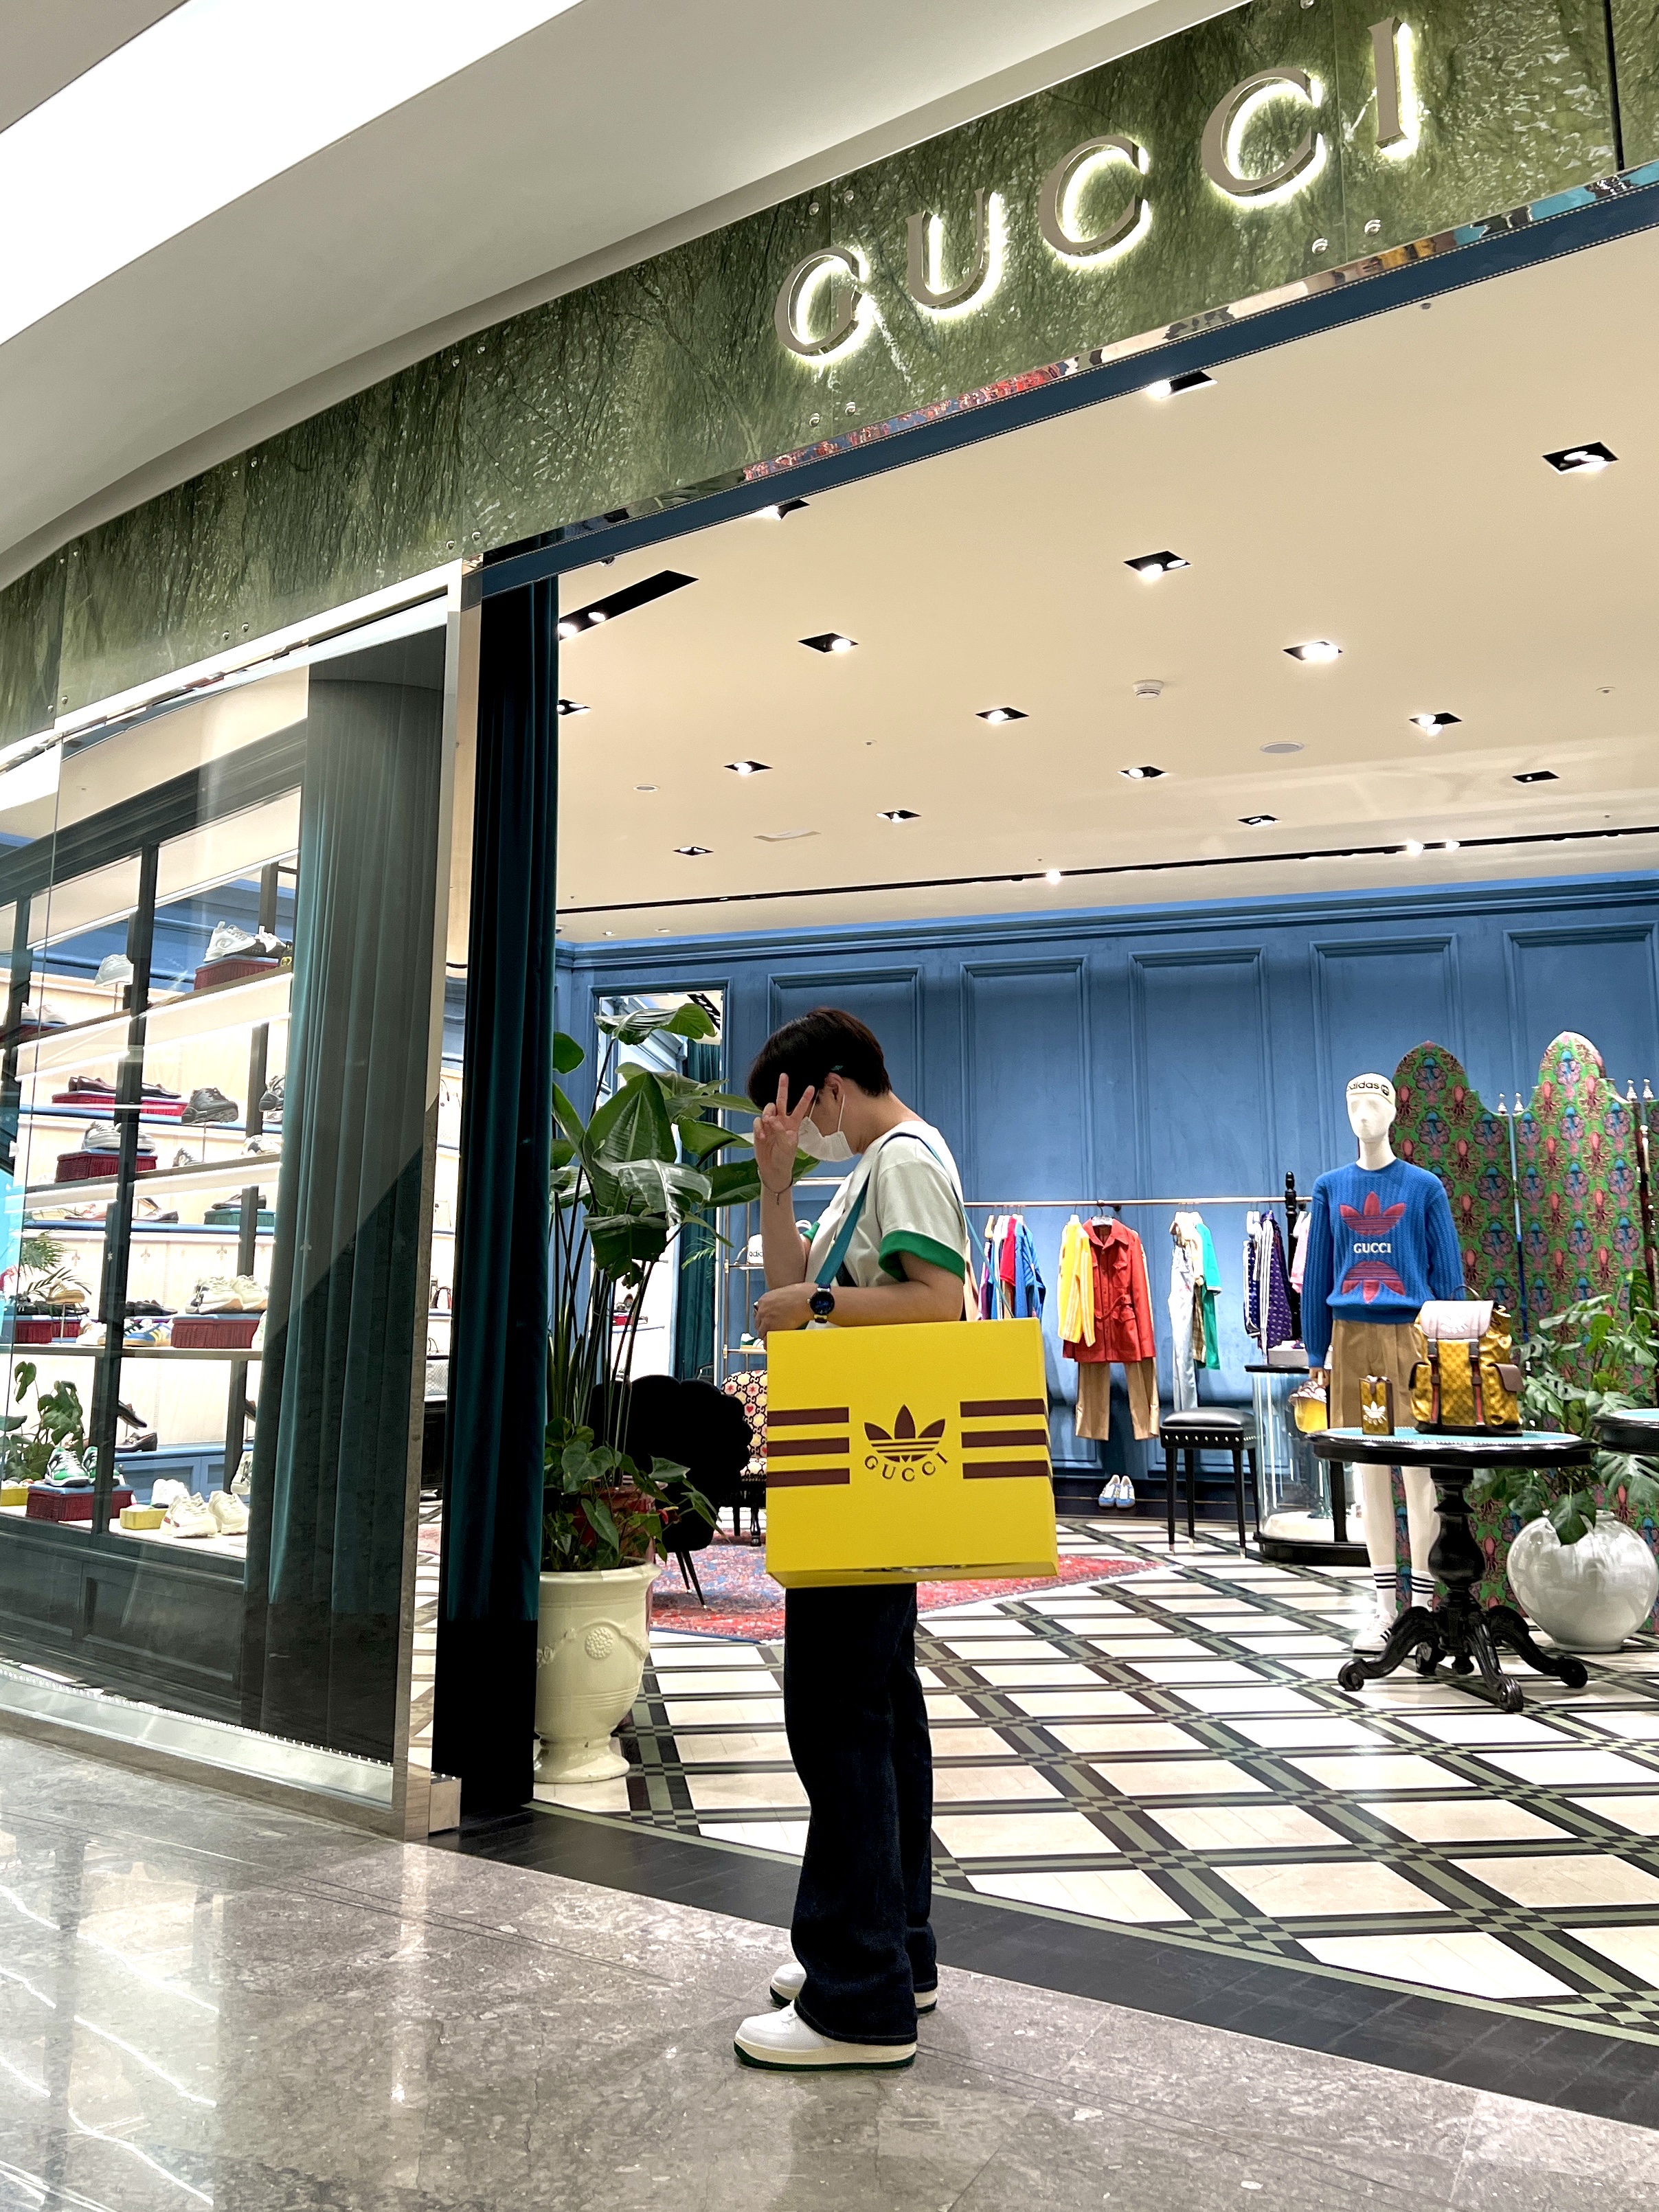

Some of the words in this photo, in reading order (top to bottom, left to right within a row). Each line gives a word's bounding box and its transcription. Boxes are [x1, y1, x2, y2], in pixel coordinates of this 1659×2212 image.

[774, 15, 1415, 357] GUCCI
[1346, 1081, 1380, 1092] didas
[1353, 1242, 1392, 1254] GUCCI
[864, 1452, 949, 1482] GUCCI
